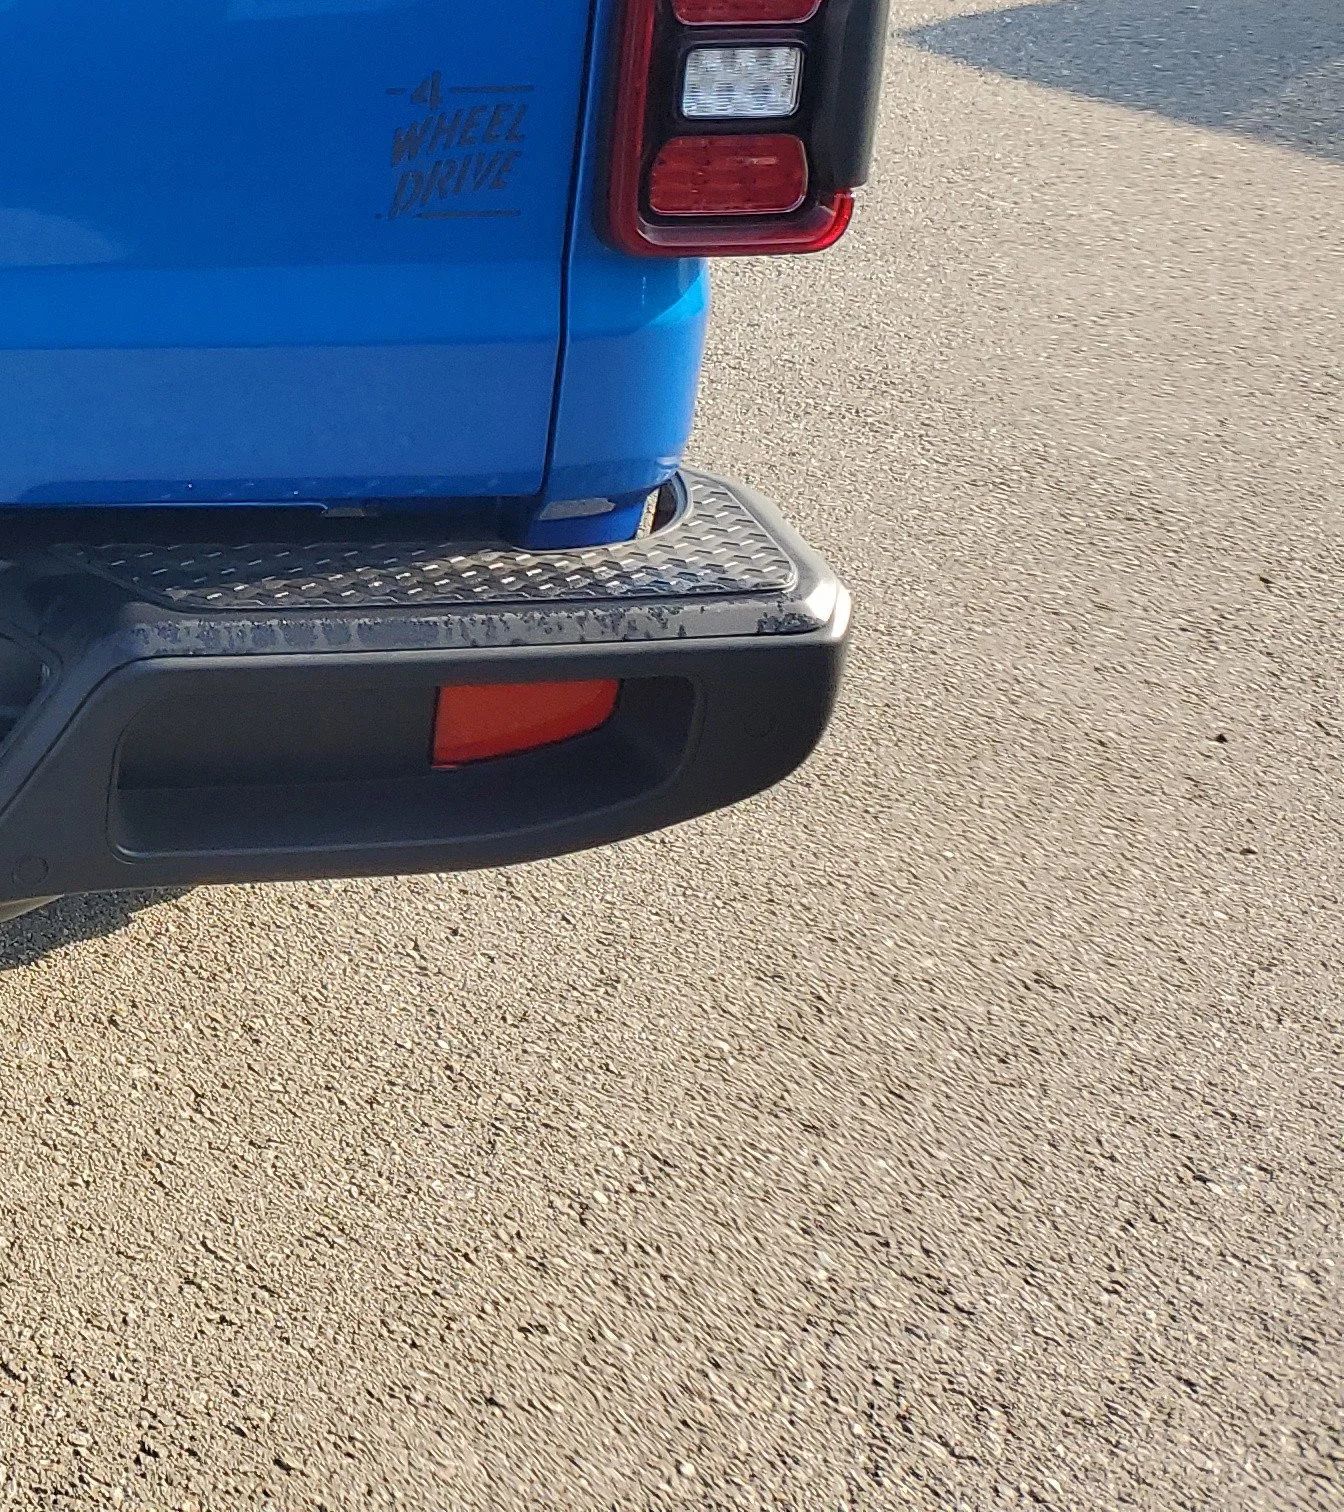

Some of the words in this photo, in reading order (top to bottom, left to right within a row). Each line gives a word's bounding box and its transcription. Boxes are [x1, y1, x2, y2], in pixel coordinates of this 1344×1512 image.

[410, 70, 443, 110] 4
[390, 104, 529, 168] WHEEL
[388, 149, 522, 220] DRIVE
